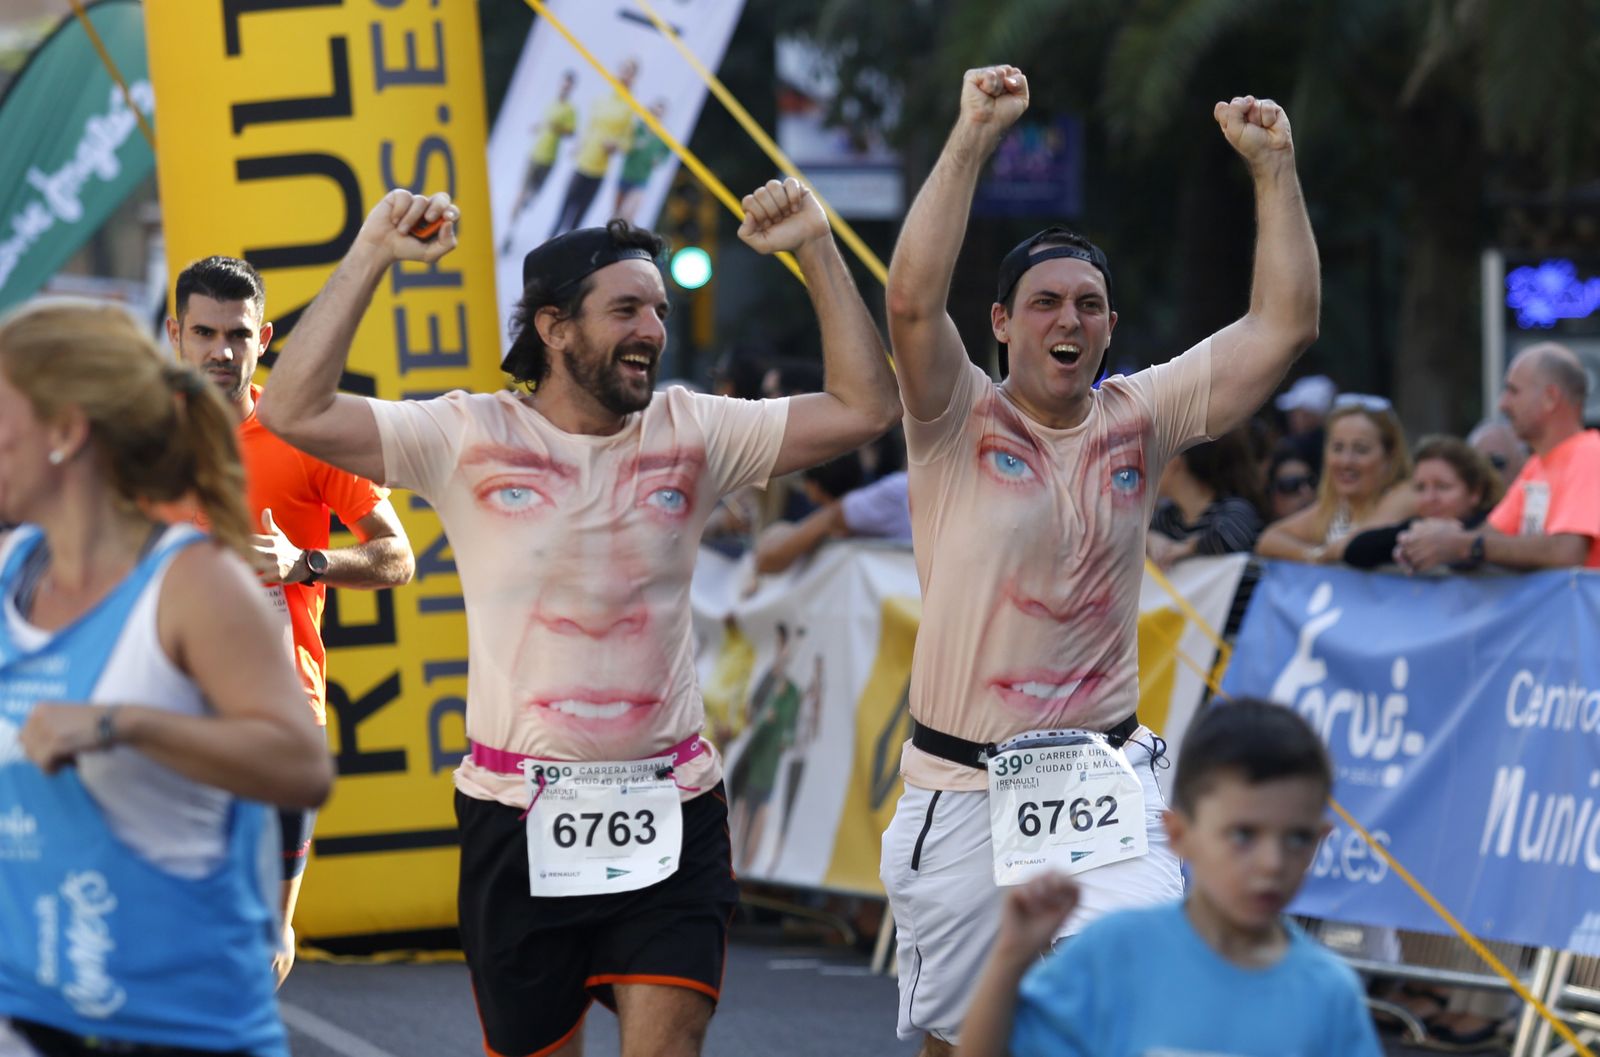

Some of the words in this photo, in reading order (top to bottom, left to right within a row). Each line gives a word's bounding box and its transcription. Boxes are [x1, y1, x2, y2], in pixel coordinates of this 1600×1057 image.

[1505, 668, 1600, 735] Centro
[1039, 750, 1085, 761] CARRERA
[1088, 747, 1112, 757] URB
[578, 766, 627, 775] CARRERA
[1035, 763, 1073, 774] CIUDAD
[1076, 761, 1089, 771] DE
[1093, 759, 1121, 769] MÁLA
[1000, 777, 1035, 786] RENAULT
[1017, 795, 1119, 837] 6762
[552, 809, 657, 850] 6763
[1014, 858, 1046, 866] RENAULT
